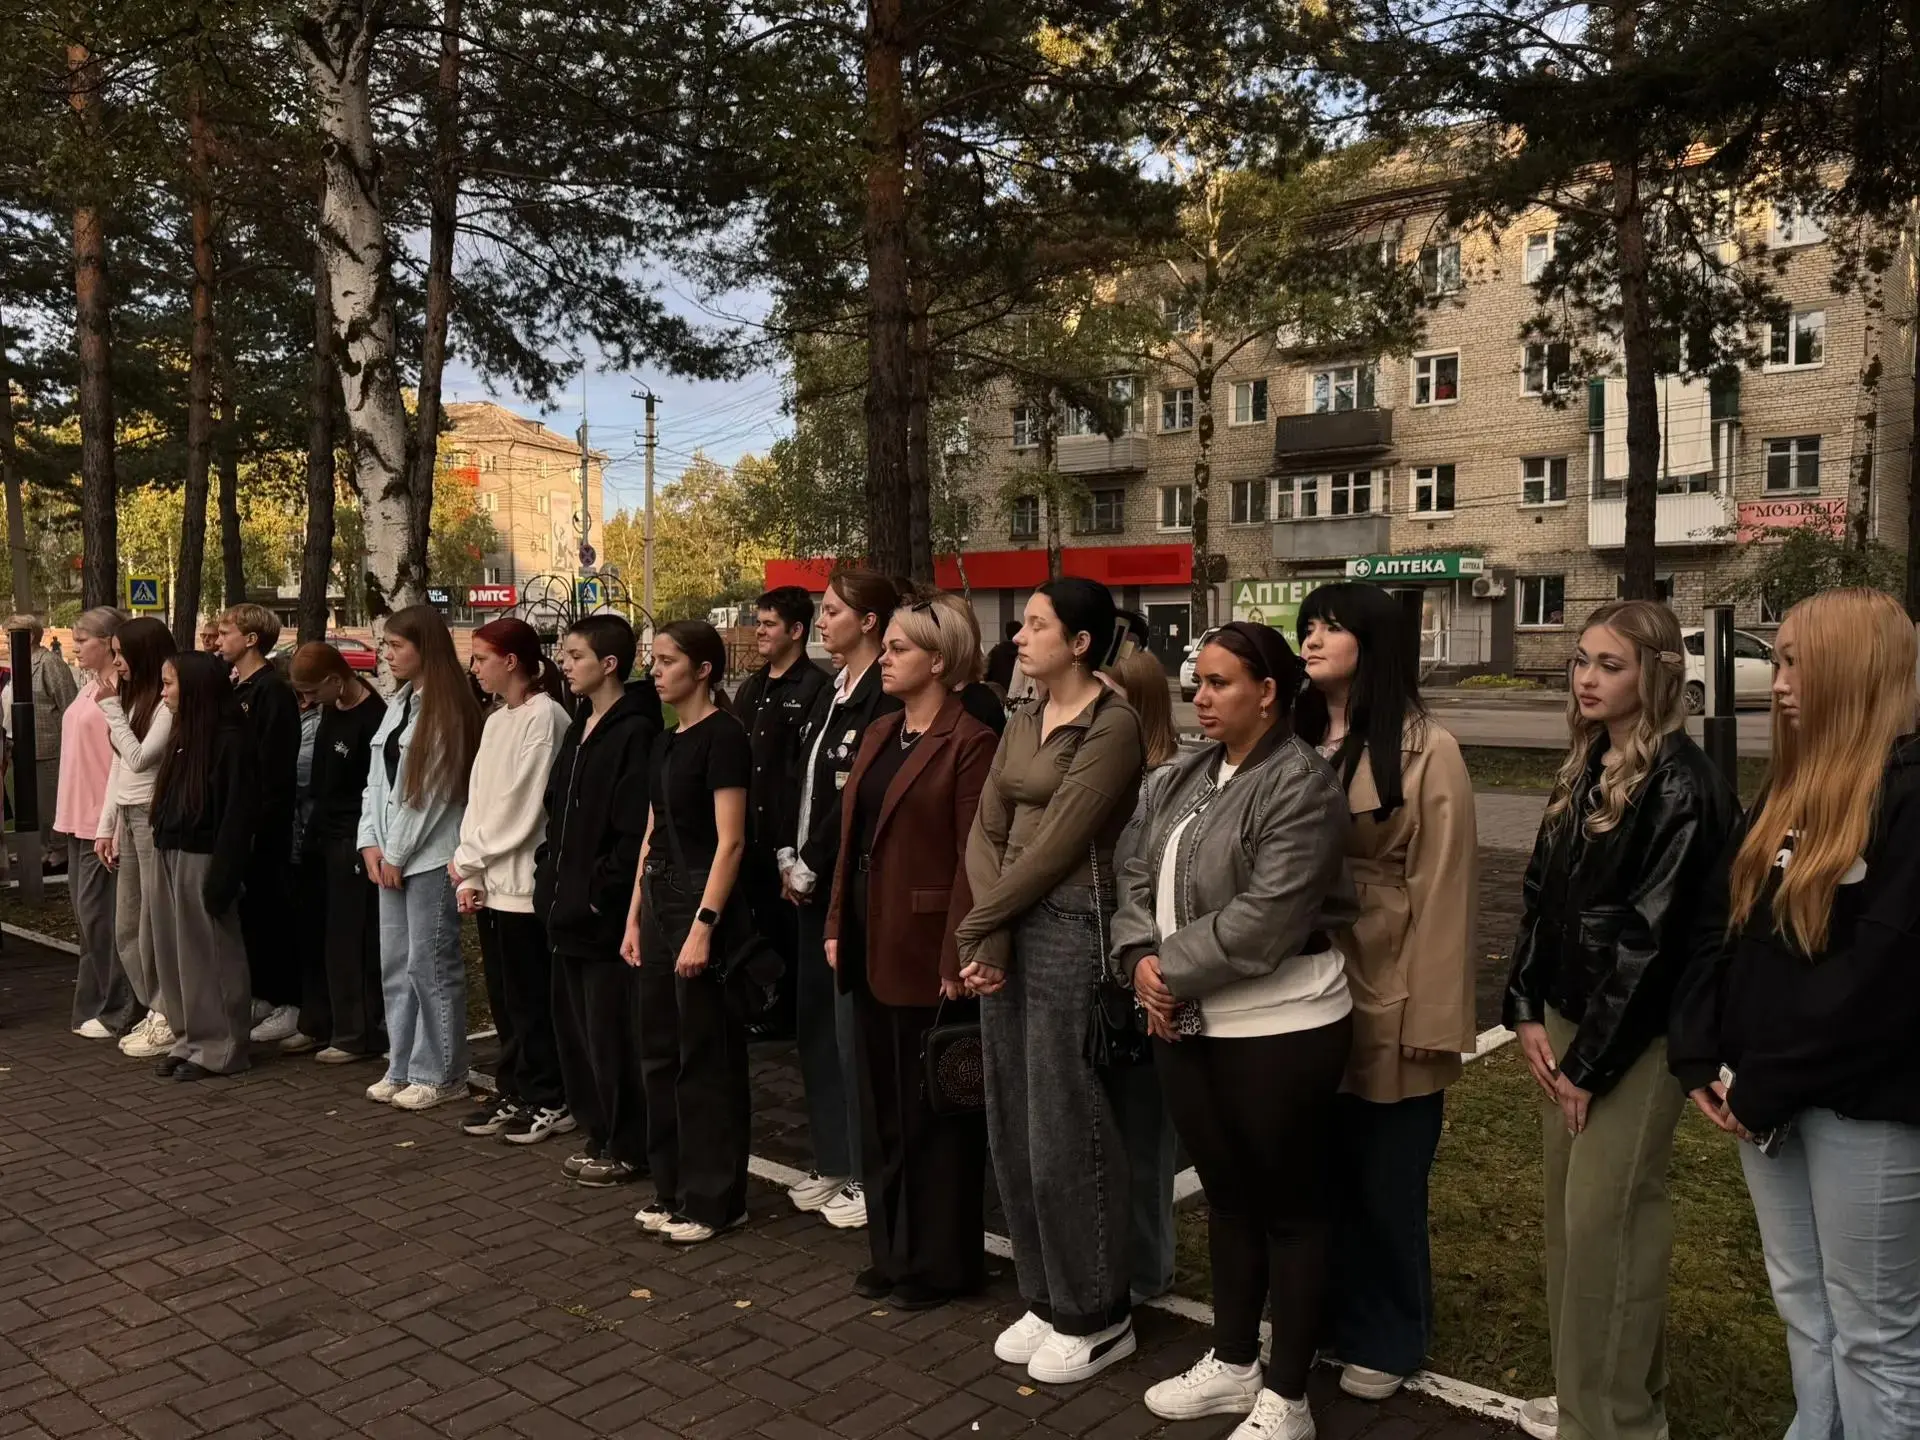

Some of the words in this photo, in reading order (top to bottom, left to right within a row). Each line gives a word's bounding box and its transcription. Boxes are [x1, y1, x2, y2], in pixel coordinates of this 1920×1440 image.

[1803, 514, 1847, 527] СЕЗО
[1375, 559, 1446, 574] АПТЕКА
[478, 590, 510, 602] МТС
